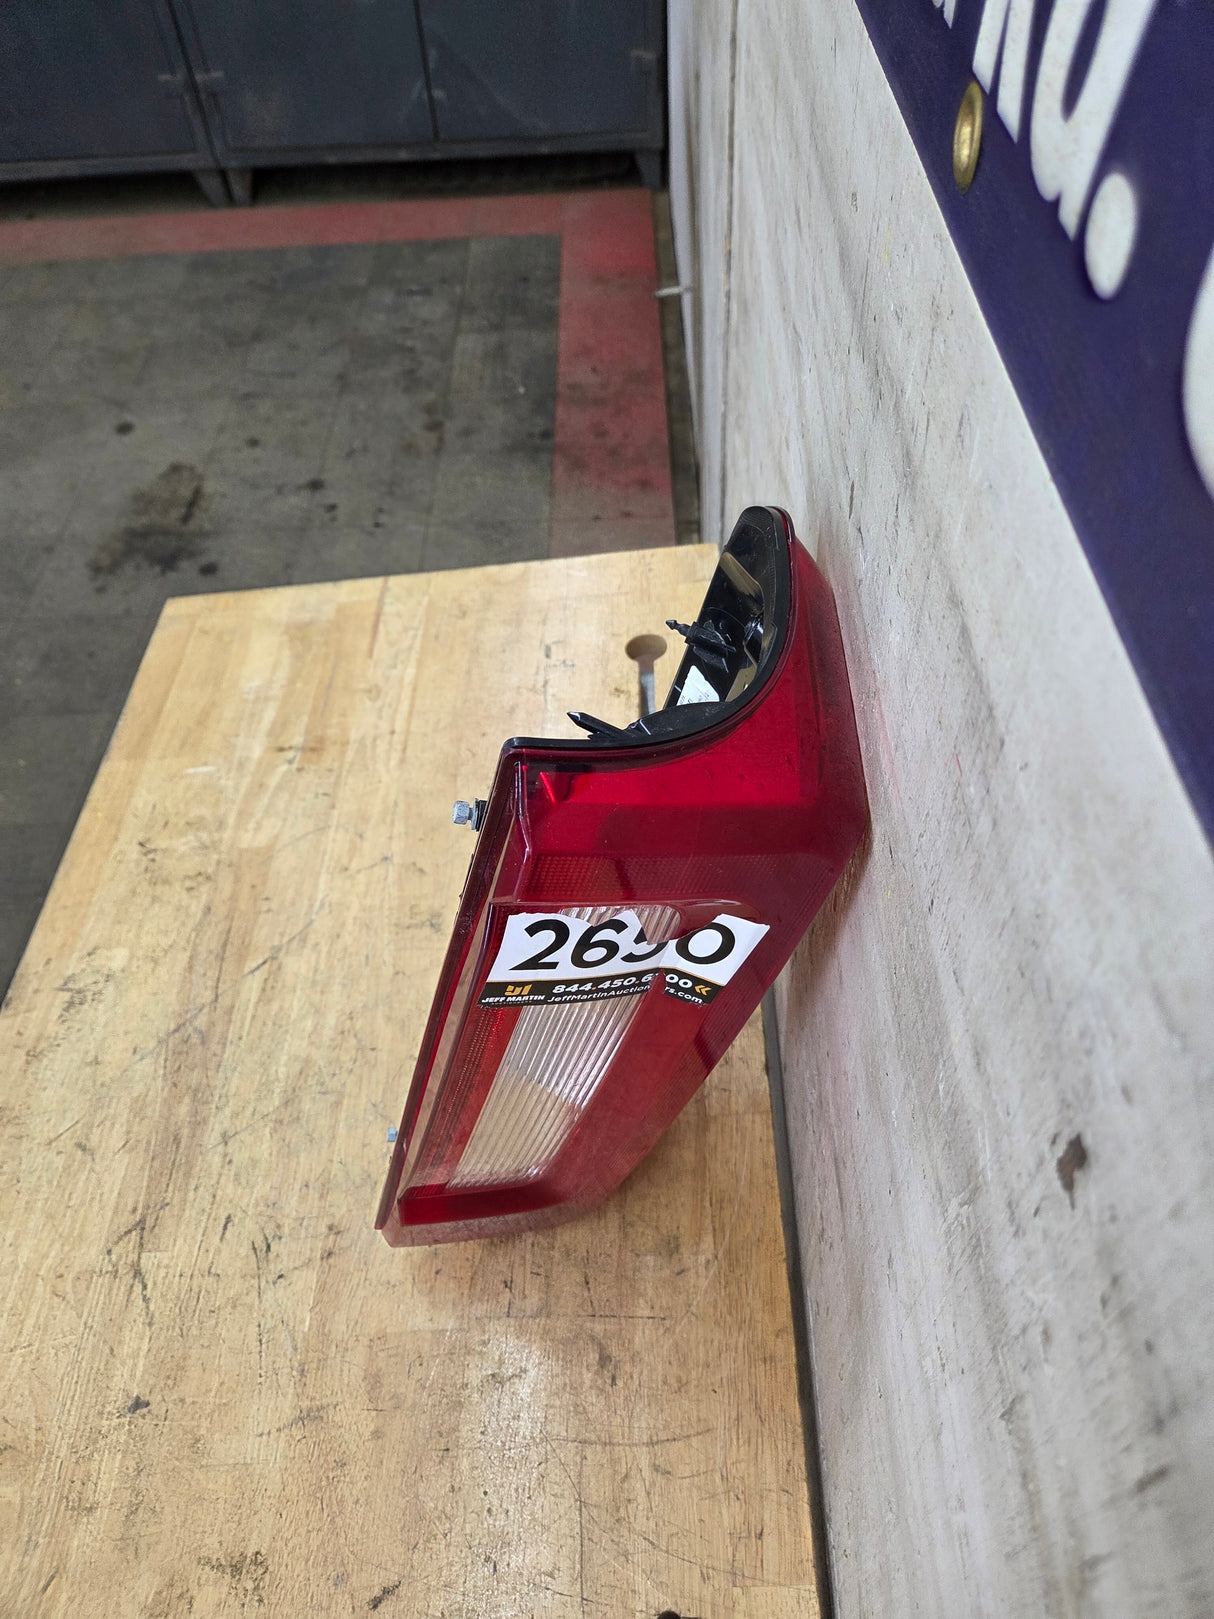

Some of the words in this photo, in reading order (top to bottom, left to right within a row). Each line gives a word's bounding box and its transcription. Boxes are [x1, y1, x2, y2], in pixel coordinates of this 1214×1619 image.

[552, 972, 693, 994] 844.450.600
[506, 994, 546, 1002] MARTIN
[547, 984, 703, 1004] JeffMartinAuctionrs.com
